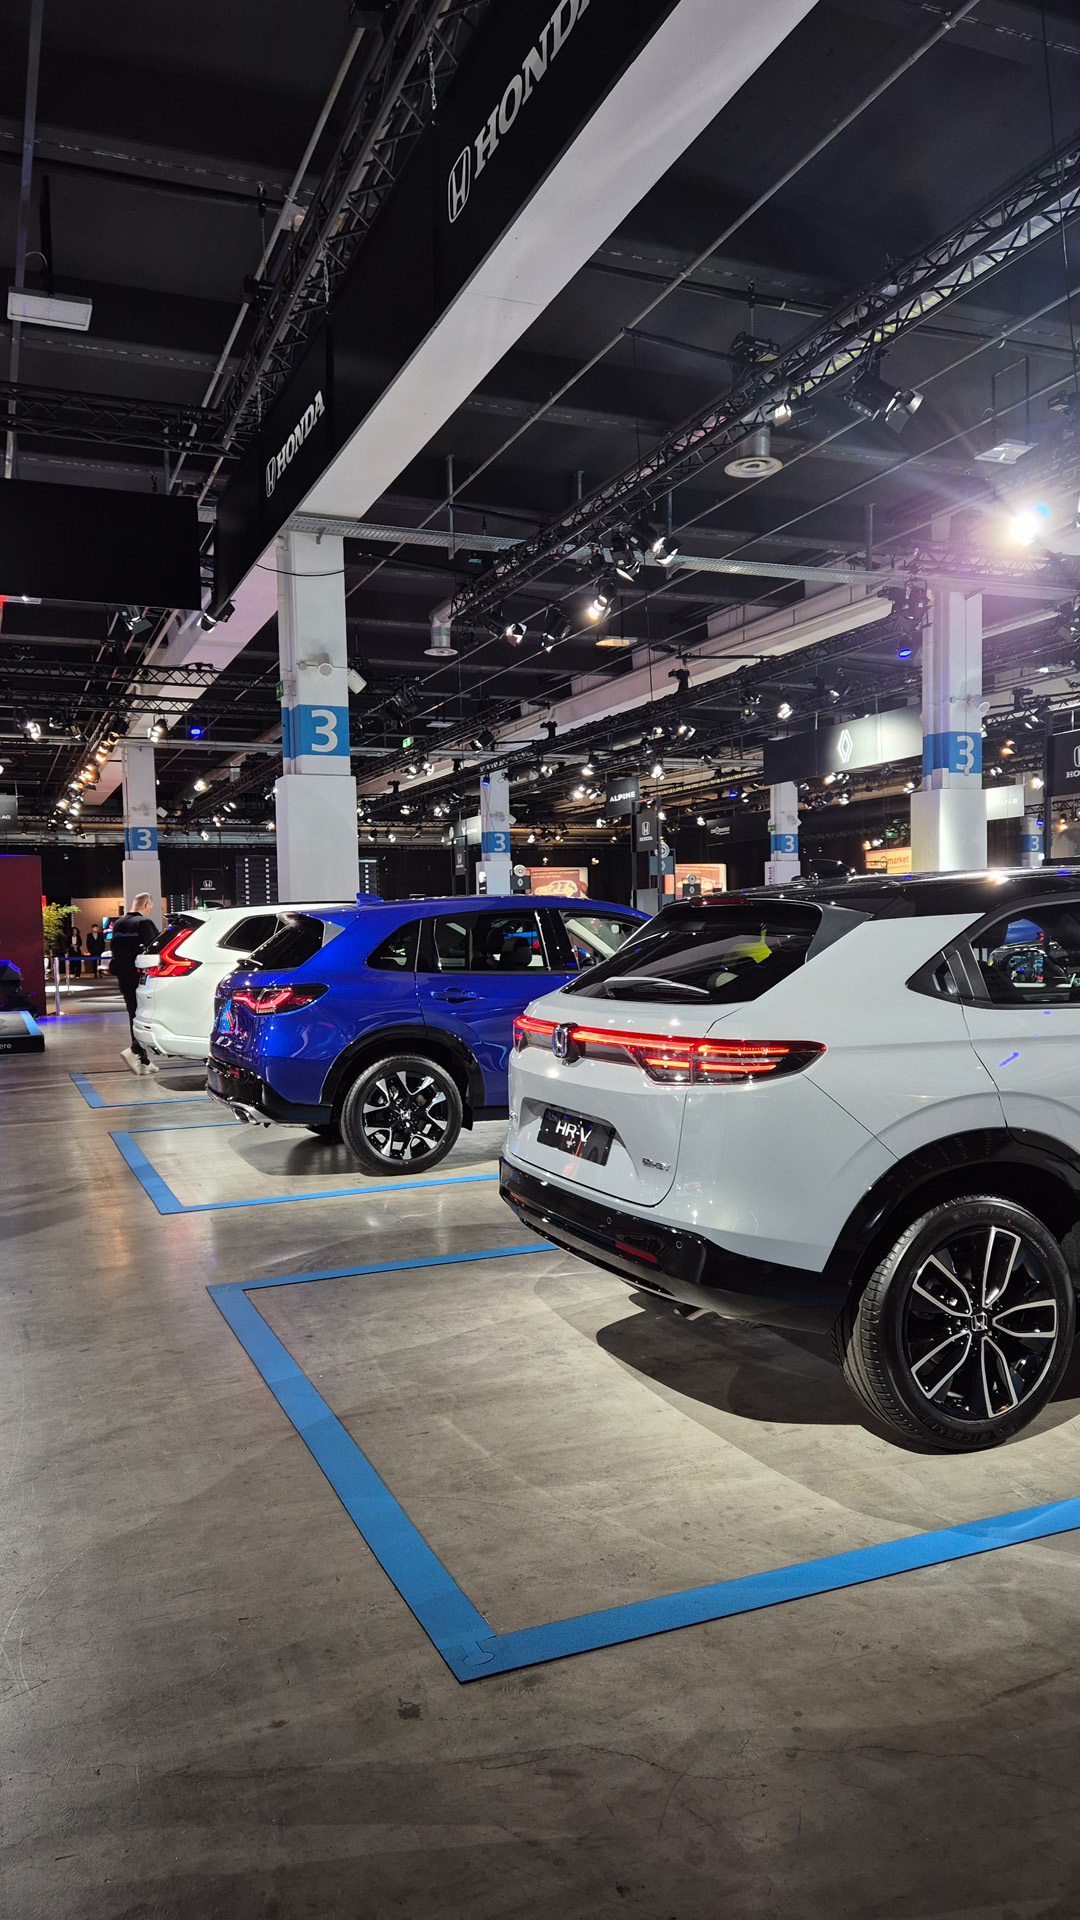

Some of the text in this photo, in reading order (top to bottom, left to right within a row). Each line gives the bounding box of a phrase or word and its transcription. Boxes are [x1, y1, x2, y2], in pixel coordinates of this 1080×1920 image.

[276, 390, 326, 480] HONDA
[311, 709, 338, 752] 3
[956, 735, 975, 771] 3
[609, 791, 636, 802] ALPINE
[137, 829, 152, 849] 3
[494, 833, 506, 852] 3
[785, 835, 795, 852] 3
[1031, 835, 1040, 852] 3
[887, 856, 910, 864] market
[555, 1120, 592, 1142] HR-V
